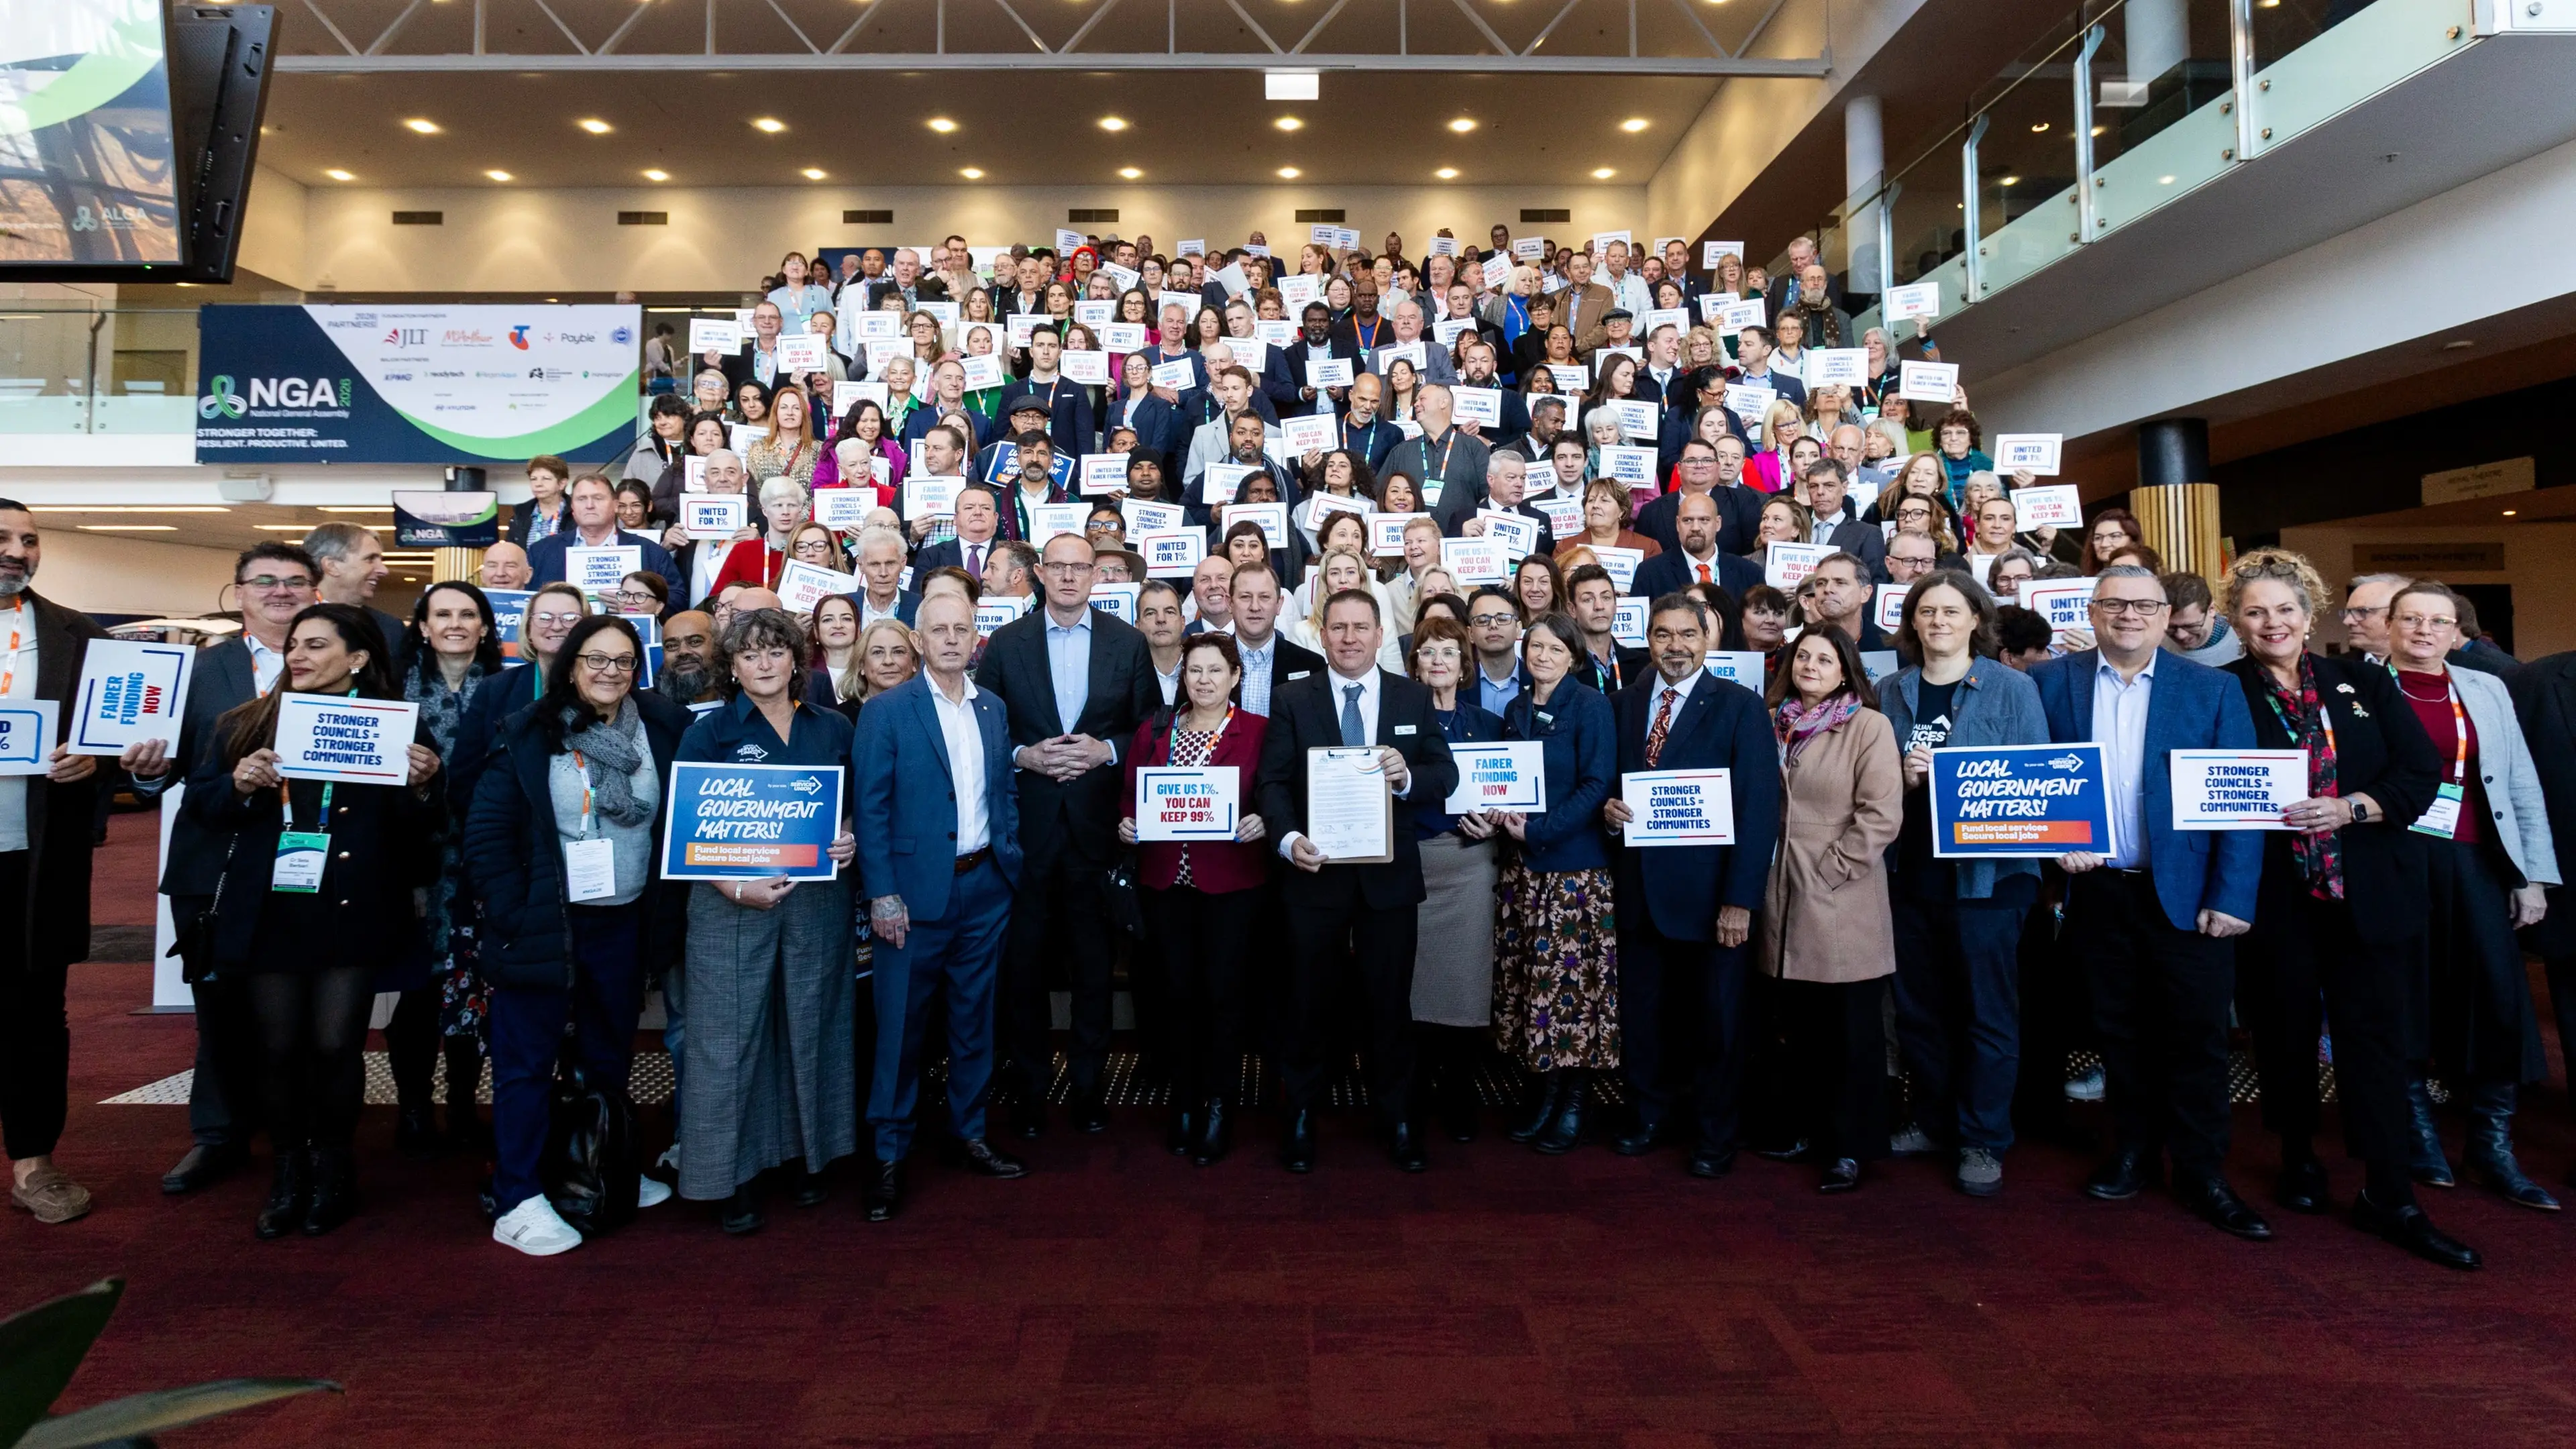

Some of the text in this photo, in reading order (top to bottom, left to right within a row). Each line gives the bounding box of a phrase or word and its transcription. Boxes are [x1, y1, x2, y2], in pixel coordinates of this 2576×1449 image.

[101, 207, 148, 220] ALGA
[399, 329, 429, 348] JLT
[561, 333, 596, 344] Payble
[384, 374, 413, 382] KPMG
[250, 377, 338, 407] NGA
[339, 378, 352, 407] 2026
[313, 410, 350, 419] Assembly
[197, 428, 318, 437] STRONGER TOGETHER:
[197, 439, 349, 448] RESILIENT. PRODUCTIVE. UNITED.
[2014, 446, 2042, 454] UNITED
[1138, 509, 1167, 518] STRONGER
[1136, 516, 1162, 525] COUNCILS
[415, 529, 445, 539] NGA
[1495, 523, 1520, 535] UNITED
[1157, 542, 1186, 551] UNITED
[1157, 553, 1187, 561] FOR 1%
[1782, 553, 1799, 561] GIVE
[1787, 563, 1801, 572] YOU
[798, 574, 827, 587] GIVE US
[1782, 572, 1801, 580] KEEP
[802, 584, 816, 594] YOU
[795, 592, 816, 602] KEEP
[2052, 611, 2074, 623] FOR
[101, 676, 123, 719] FAIRER
[120, 672, 144, 725] FUNDING
[142, 686, 162, 714] NOW
[317, 712, 379, 728] STRONGER
[313, 726, 370, 740] COUNCILS
[313, 738, 375, 752] STRONGER
[303, 750, 382, 765] COMMUNITIES
[1475, 758, 1513, 769] FAIRER
[1956, 759, 2012, 778] LOCAL
[1471, 771, 1517, 783] FUNDING
[2208, 766, 2269, 777] STRONGER
[699, 777, 755, 798] LOCAL
[1957, 777, 2089, 798] GOVERNMENT
[2204, 777, 2261, 788] COUNCILS
[1157, 784, 1219, 795] GIVE US 1%.
[1483, 784, 1507, 796] NOW
[1651, 786, 1701, 796] STRONGER
[2208, 790, 2269, 800] STRONGER
[1165, 798, 1211, 808] YOU CAN
[1650, 796, 1696, 807] COUNCILS
[2200, 802, 2278, 812] COMMUNITIES
[697, 799, 823, 819] GOVERNMENT
[1653, 808, 1702, 818] STRONGER
[1960, 798, 2048, 818] MATTERS!
[1161, 811, 1214, 822] KEEP 99%
[695, 820, 784, 840] MATTERS!
[1646, 819, 1711, 830] COMMUNITIES
[1962, 823, 2048, 833] Fund local services
[1962, 832, 1994, 840] Secure
[2019, 832, 2039, 841] jobs
[695, 846, 718, 854] Fund
[720, 847, 741, 855] local
[694, 854, 770, 864] Secure local jobs
